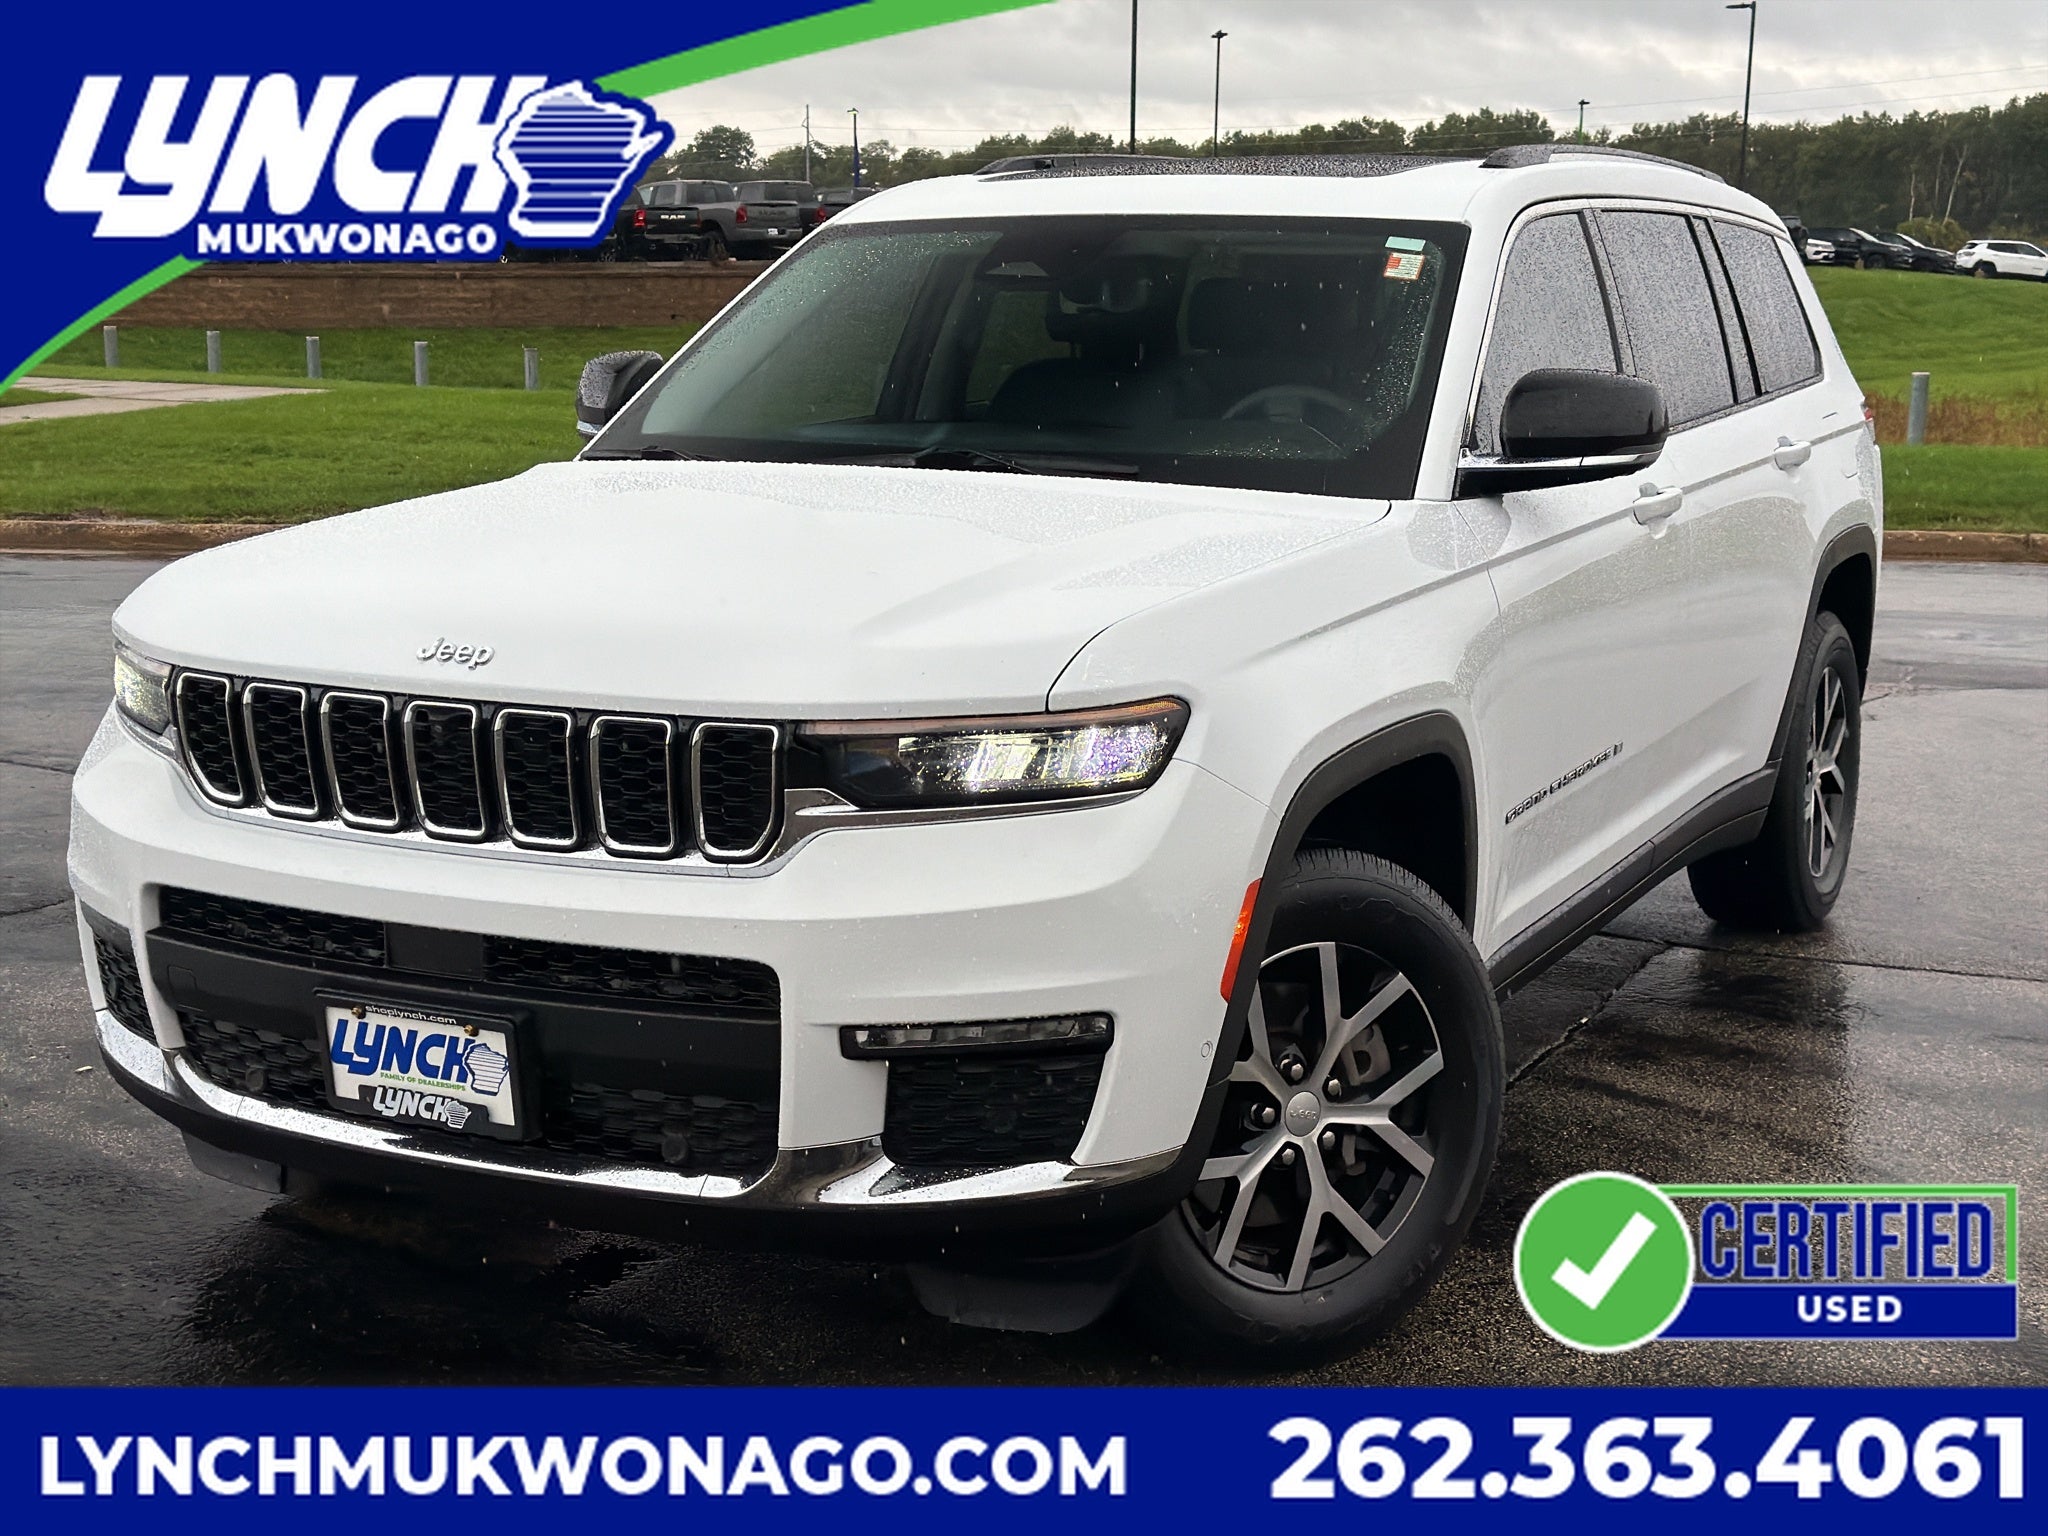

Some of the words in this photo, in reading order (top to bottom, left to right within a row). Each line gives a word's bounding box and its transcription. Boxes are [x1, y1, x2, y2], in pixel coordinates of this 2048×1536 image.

[660, 213, 687, 221] RAM
[416, 637, 495, 671] Jeep
[365, 1004, 458, 1026] shoplynch.com
[330, 1018, 476, 1084] LYNCH
[380, 1071, 406, 1083] FAMILY
[406, 1076, 417, 1084] OF
[417, 1077, 467, 1092] DEALERSHIPS
[372, 1085, 452, 1123] LYNCH
